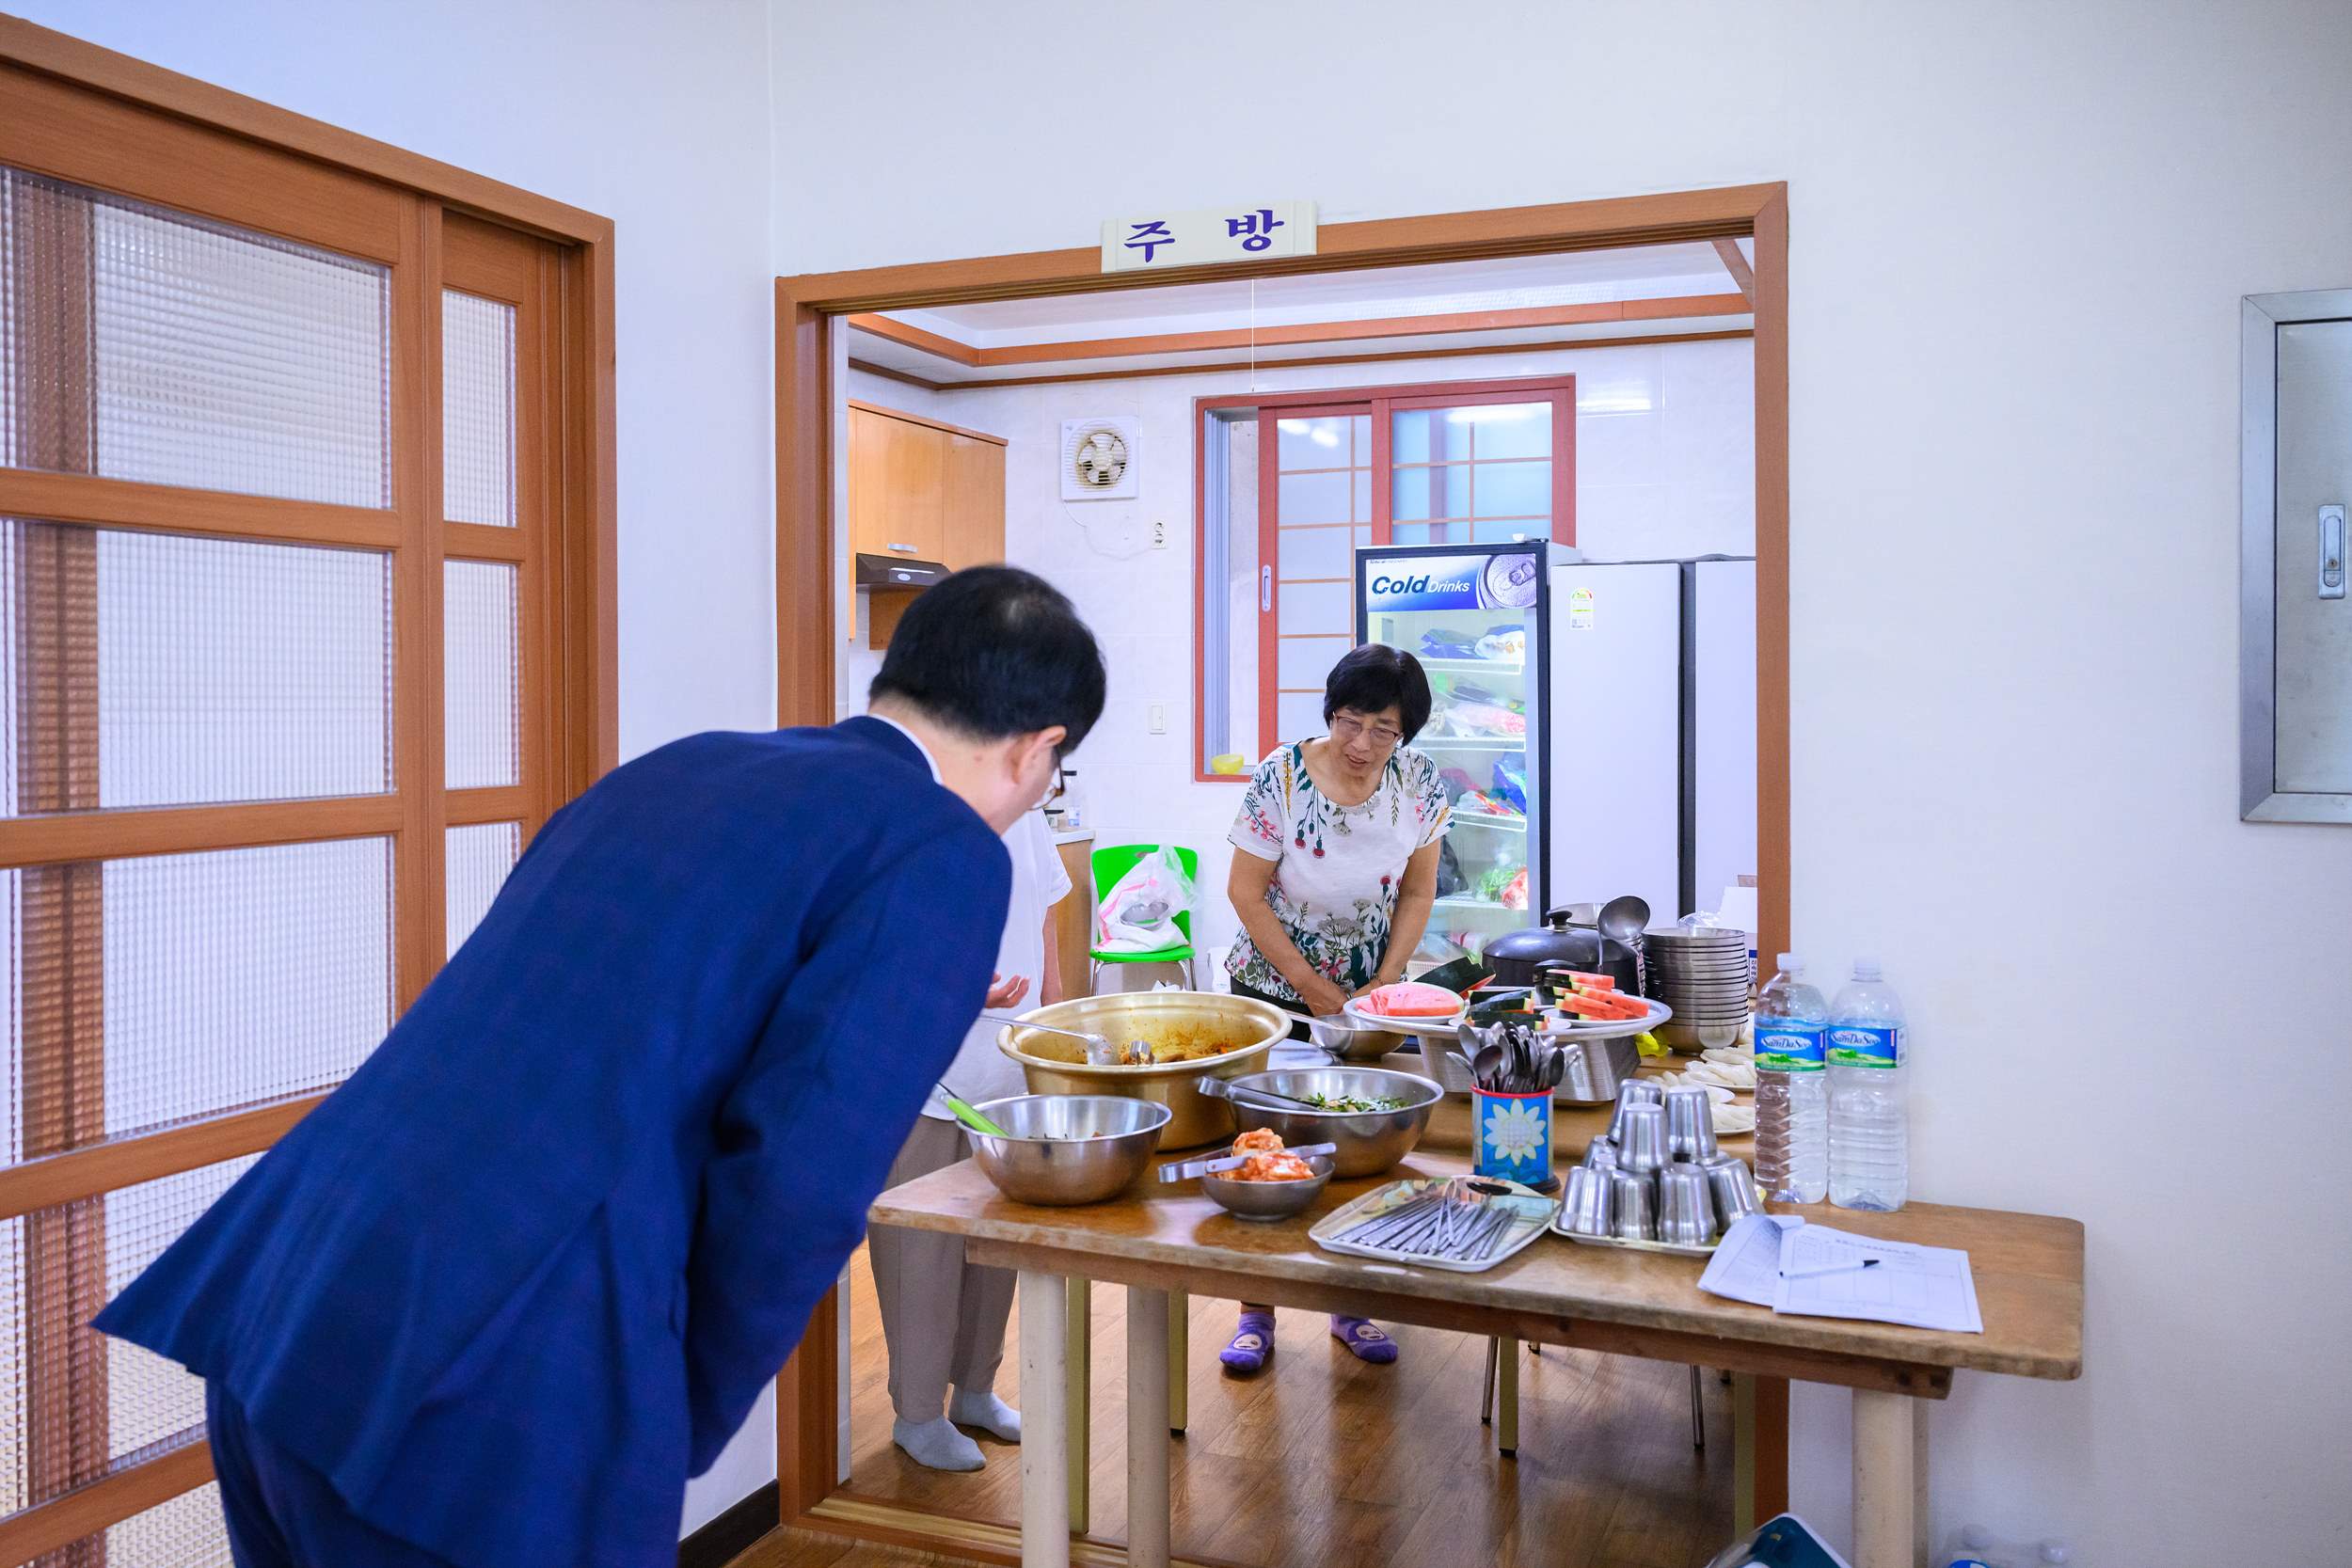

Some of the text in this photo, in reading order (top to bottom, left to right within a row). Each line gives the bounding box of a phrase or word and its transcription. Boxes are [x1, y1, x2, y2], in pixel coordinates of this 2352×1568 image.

[1124, 210, 1284, 263] 주 방
[1372, 575, 1470, 594] Cold Drinks
